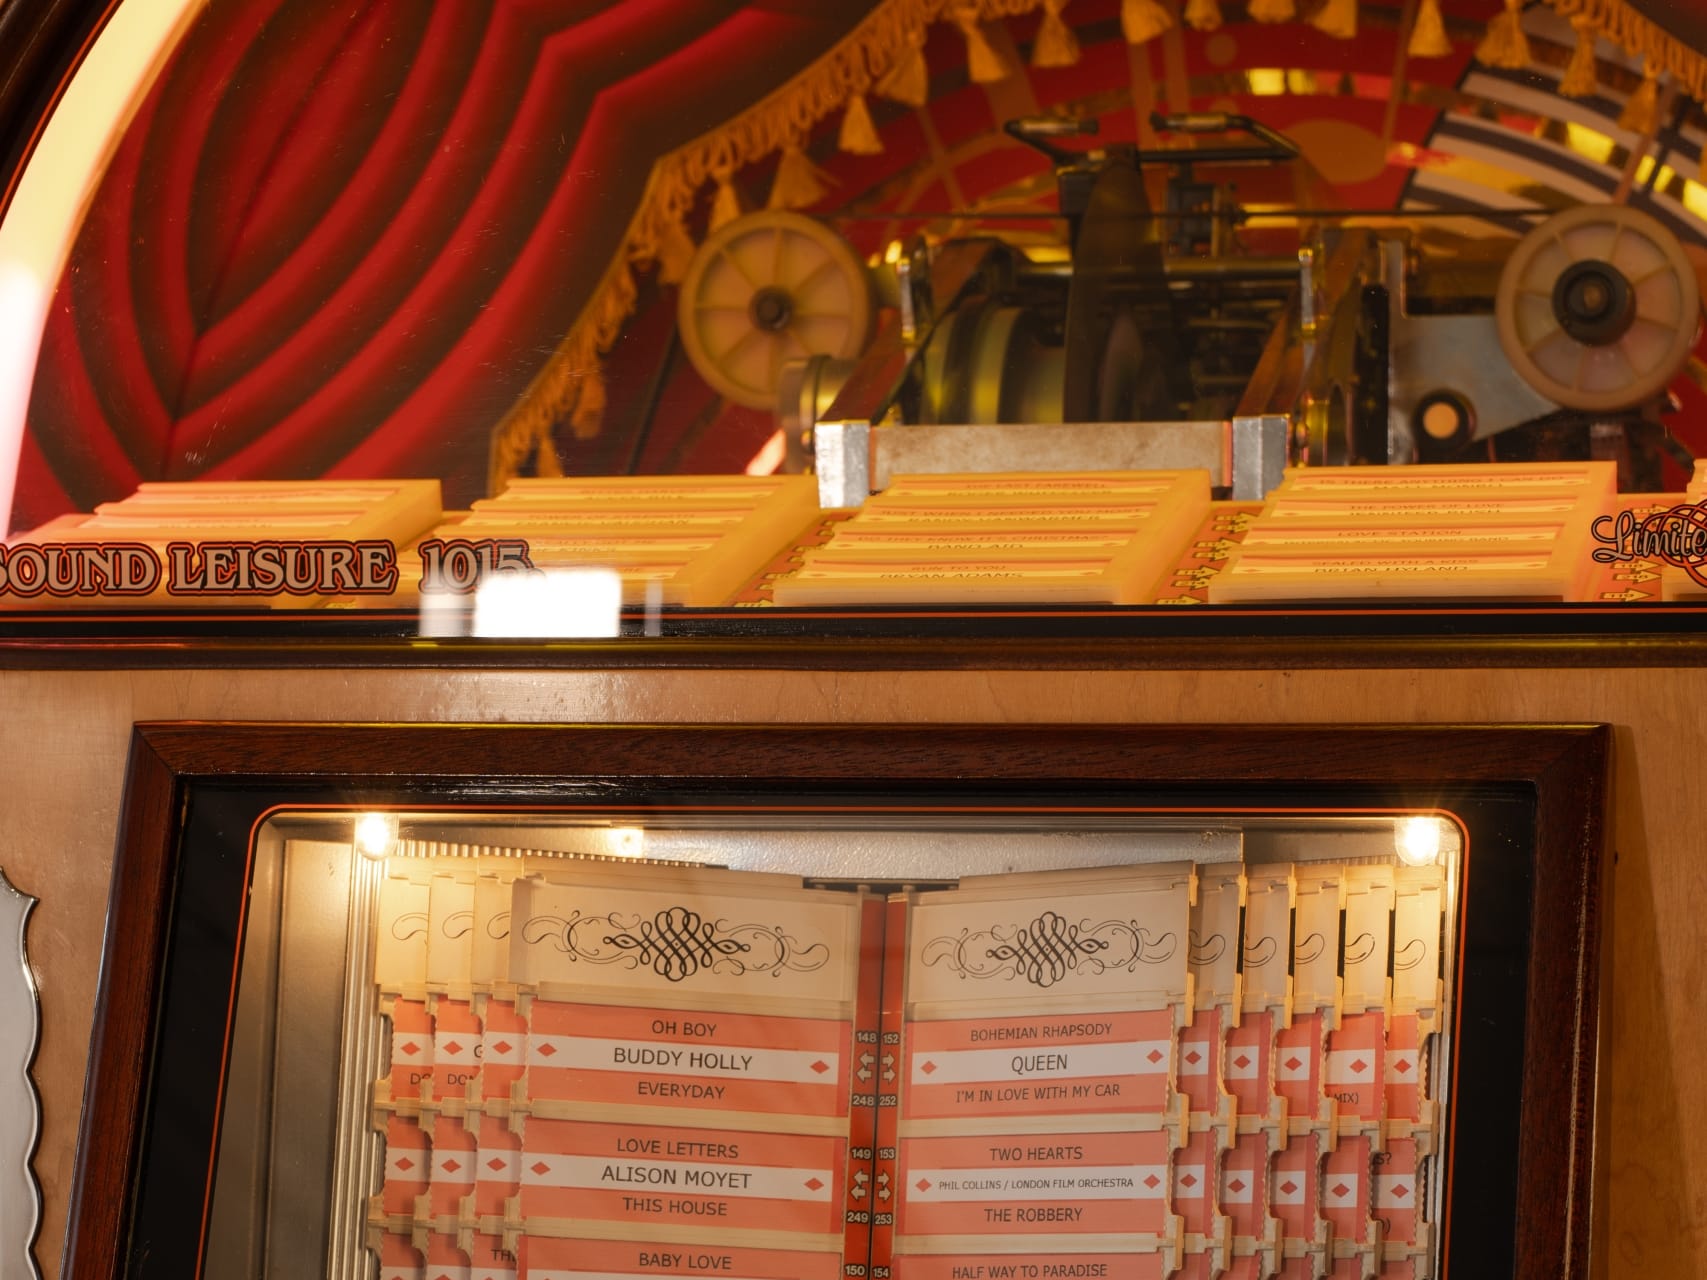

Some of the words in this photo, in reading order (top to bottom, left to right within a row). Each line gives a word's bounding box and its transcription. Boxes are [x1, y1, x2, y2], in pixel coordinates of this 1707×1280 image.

[170, 544, 397, 592] LEISURE
[651, 1019, 675, 1036] OH
[680, 1021, 717, 1038] BOY
[970, 1026, 1038, 1043] BOHEMIAN
[1042, 1023, 1113, 1039] RHAPSODY
[856, 1032, 877, 1043] 148
[882, 1033, 899, 1044] 152
[613, 1047, 684, 1067] BUDDY
[689, 1051, 753, 1071] HOLLY
[1011, 1053, 1068, 1076] QUEEN
[637, 1080, 726, 1100] EVERYDAY
[956, 1089, 975, 1104] I'M
[978, 1089, 993, 1103] IN
[996, 1087, 1030, 1102] LOVE
[1033, 1085, 1068, 1101] WITH
[1071, 1084, 1092, 1099] MY
[1094, 1083, 1121, 1097] CAR
[852, 1096, 875, 1106] 248
[879, 1096, 897, 1106] 252
[616, 1137, 662, 1155] LOVE
[666, 1140, 739, 1159] LETTERS
[852, 1149, 871, 1160] 149
[879, 1149, 895, 1160] 153
[988, 1146, 1023, 1162] TWO
[1026, 1145, 1084, 1161] HEARTS
[600, 1164, 677, 1185] ALISON
[684, 1169, 753, 1189] MOYET
[938, 1180, 961, 1191] PHIL
[961, 1179, 1002, 1191] COLLINS
[1002, 1179, 1010, 1192] /
[1011, 1178, 1051, 1190] LONDON
[1052, 1178, 1075, 1189] FILM
[1077, 1176, 1134, 1189] ORCHESTRA
[621, 1196, 663, 1213] THIS
[668, 1199, 728, 1217] HOUSE
[983, 1208, 1013, 1223] THE
[1016, 1207, 1084, 1223] ROBBERY
[847, 1212, 869, 1223] 249
[874, 1214, 893, 1225] 253
[638, 1252, 683, 1268] BABY
[687, 1254, 733, 1271] LOVE
[845, 1265, 865, 1276] 150
[873, 1267, 889, 1279] 154
[952, 1265, 985, 1280] HALF
[987, 1265, 1018, 1279] WAY
[1019, 1264, 1039, 1279] TO
[1042, 1263, 1108, 1278] PARADISE
